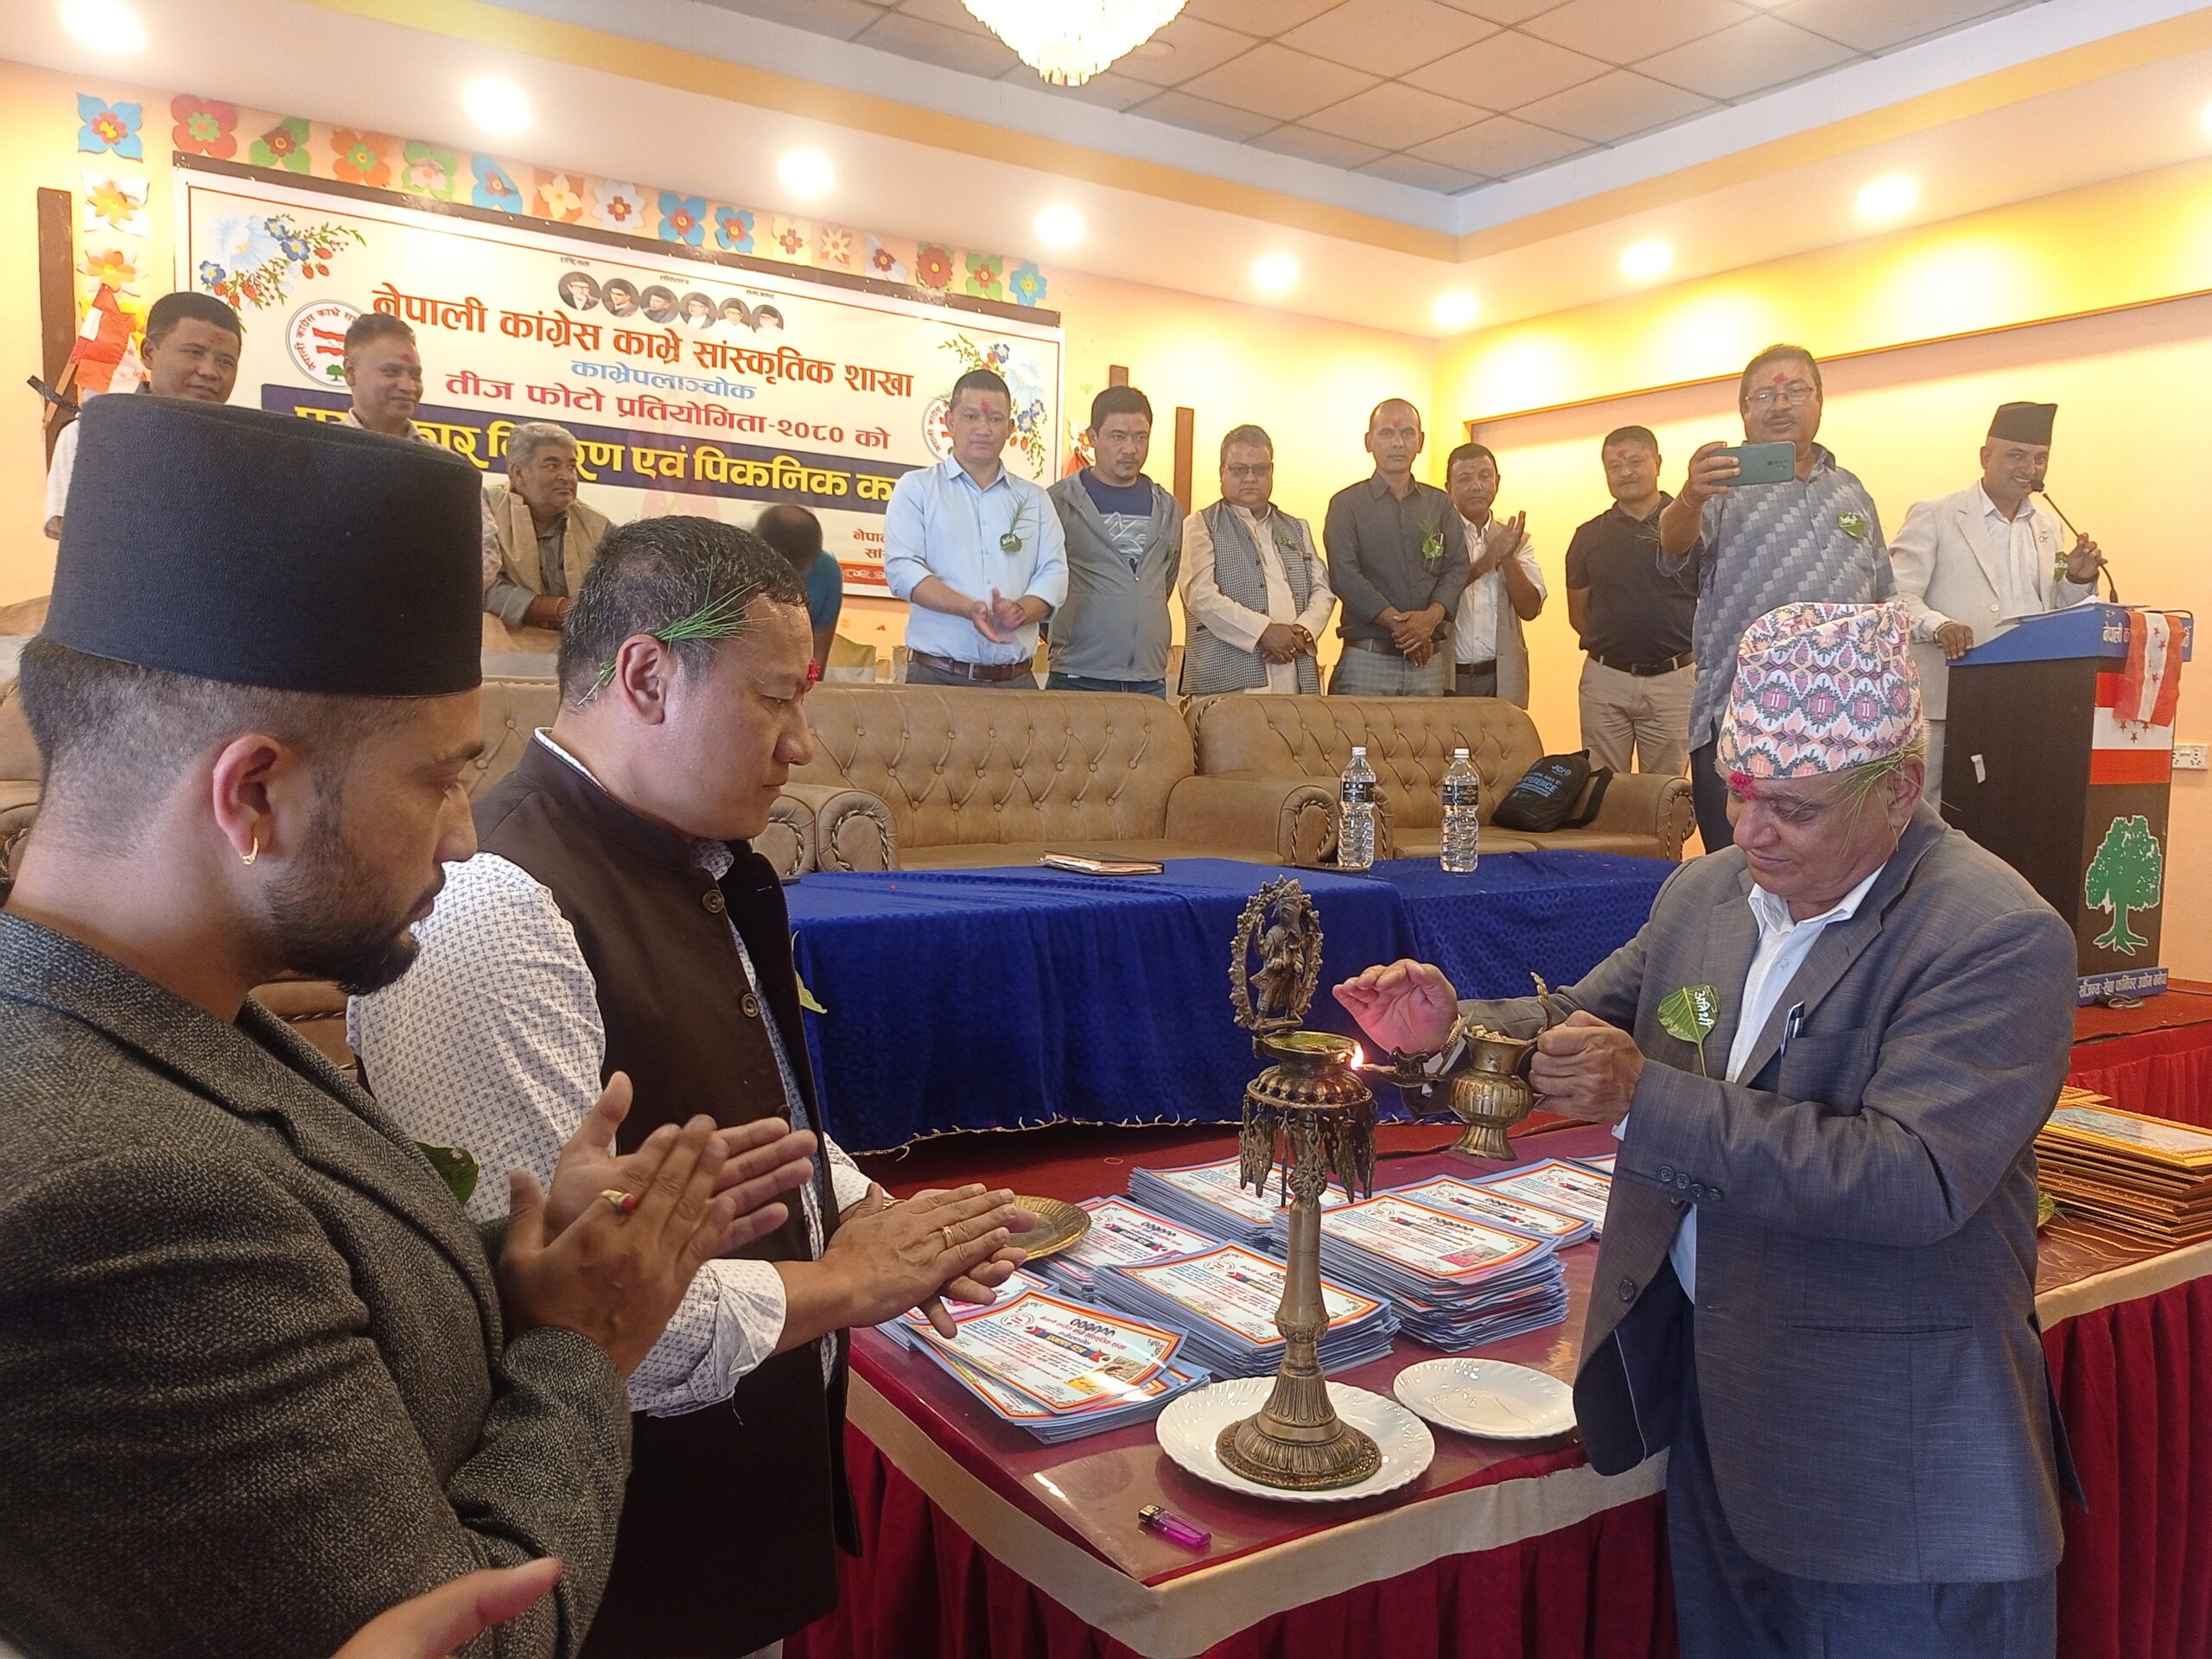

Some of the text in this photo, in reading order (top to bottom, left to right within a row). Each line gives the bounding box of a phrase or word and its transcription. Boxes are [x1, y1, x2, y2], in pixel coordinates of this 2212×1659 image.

[372, 282, 914, 397] नेपाली कांग्रेस काभ्रे सांस्कृतिक शाखा
[445, 370, 515, 400] तीज
[525, 383, 606, 412] फोटो
[855, 427, 892, 449] को
[632, 445, 688, 480] एवं
[694, 446, 851, 497] पिकनिक
